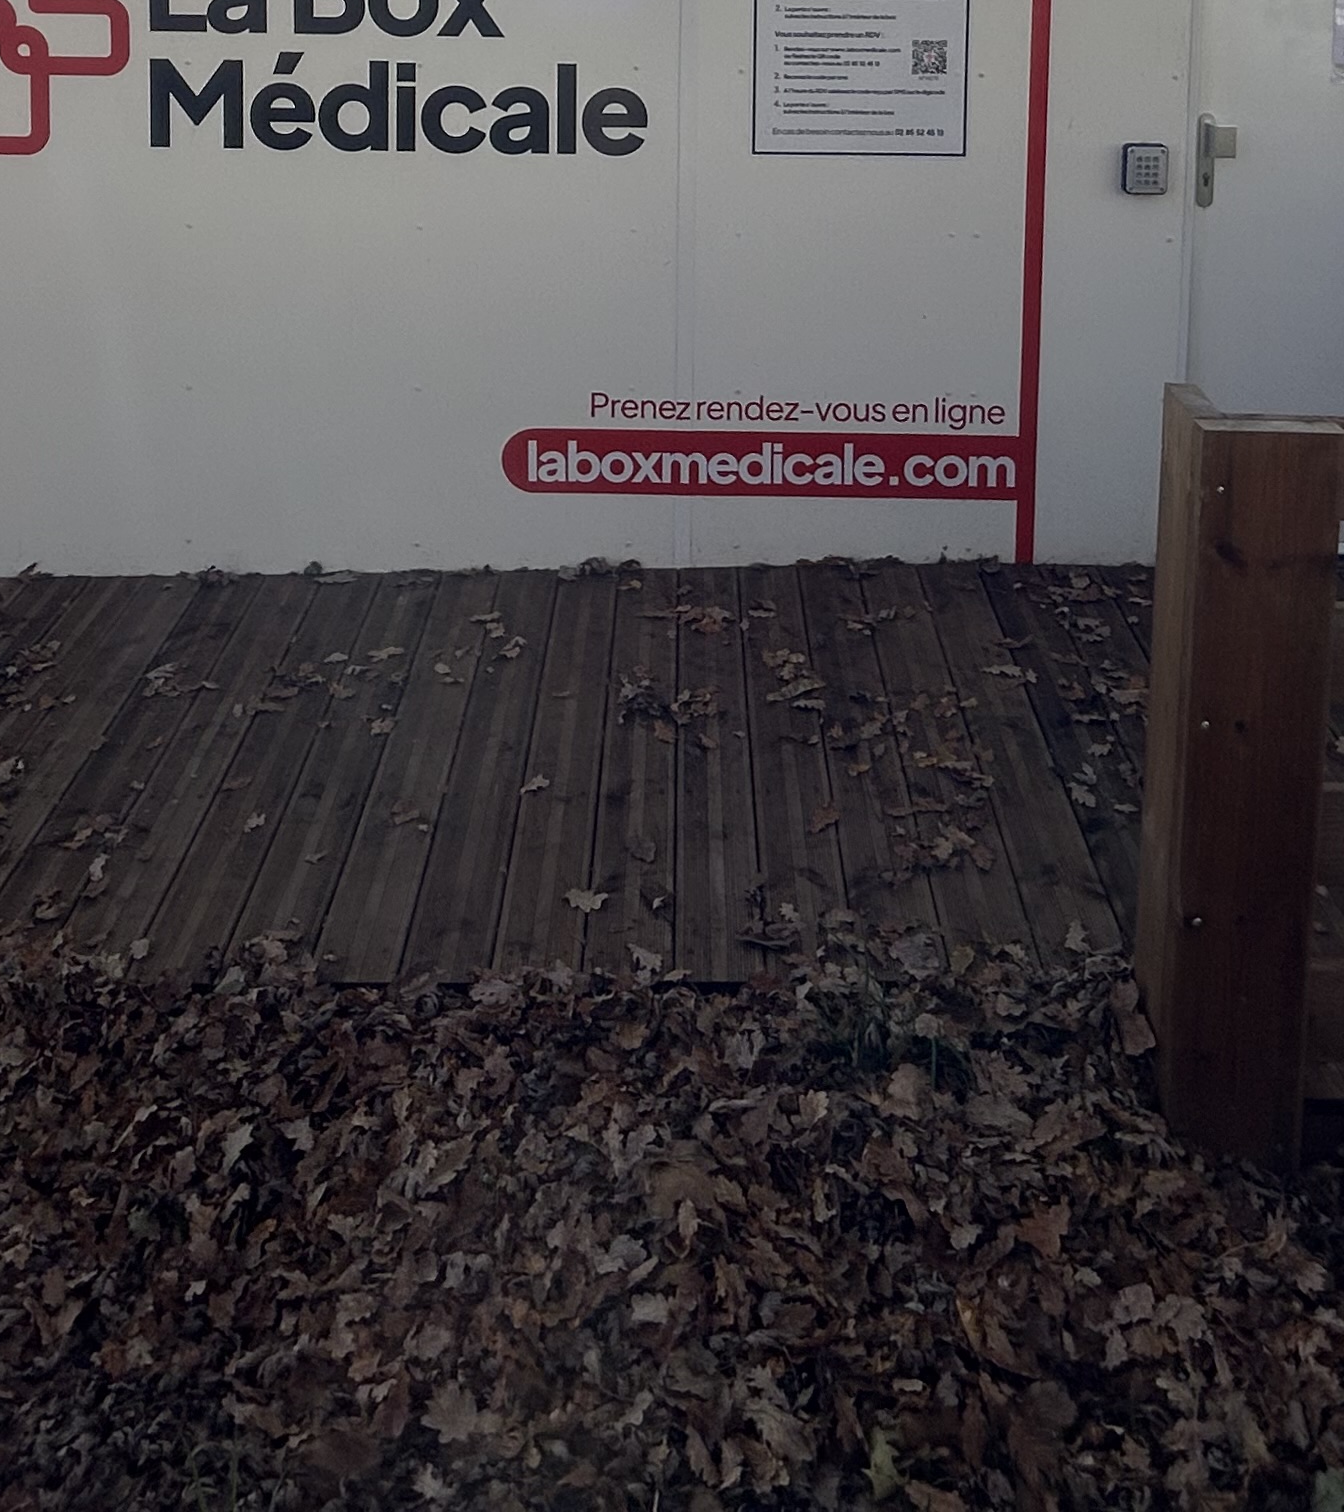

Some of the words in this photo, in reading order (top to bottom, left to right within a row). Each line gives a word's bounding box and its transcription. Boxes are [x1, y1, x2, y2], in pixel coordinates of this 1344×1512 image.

[148, 51, 649, 156] Médicale
[590, 392, 692, 422] Prenez
[696, 396, 886, 424] rendez-vous
[892, 400, 929, 424] en
[934, 397, 1006, 430] ligne
[527, 439, 1016, 488] laboxmedicale.com
